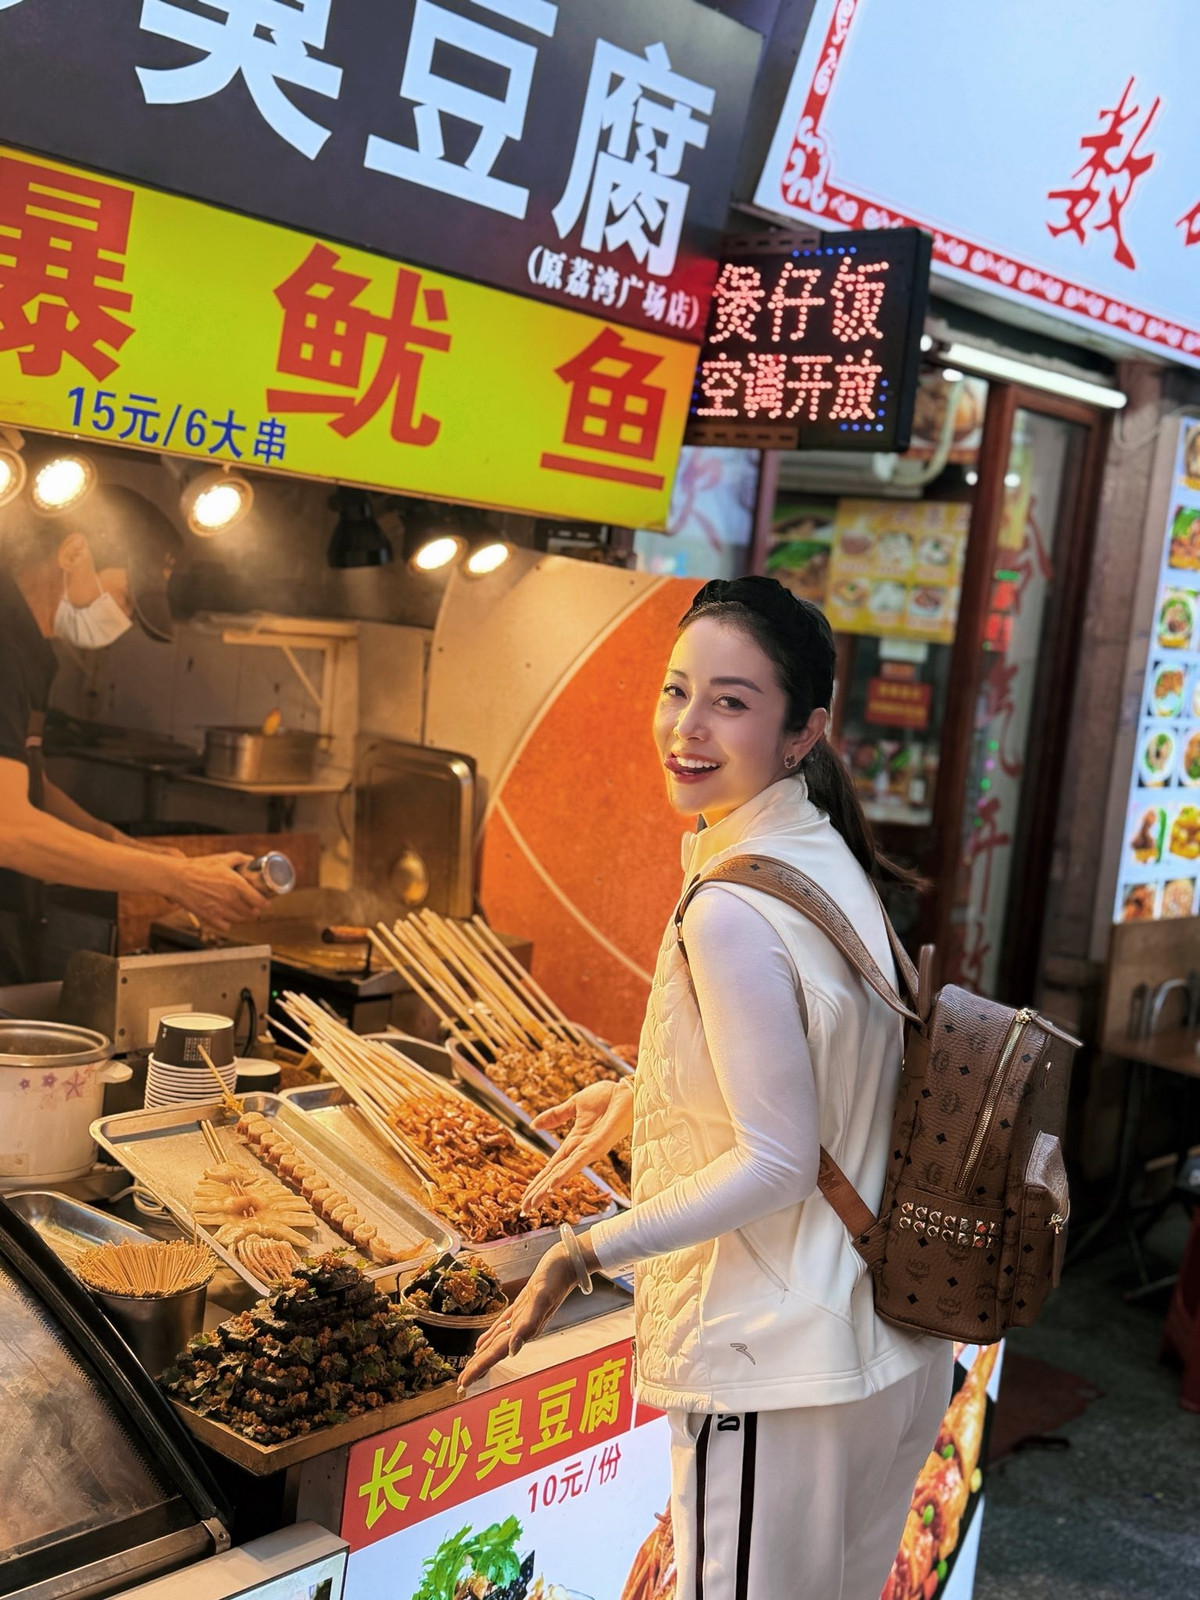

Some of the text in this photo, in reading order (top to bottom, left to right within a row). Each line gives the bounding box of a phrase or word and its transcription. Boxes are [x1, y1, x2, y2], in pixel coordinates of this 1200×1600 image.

[0, 0, 716, 277] 臭豆腐
[1046, 75, 1200, 270] 数
[709, 256, 889, 343] 煲仔饭
[68, 386, 287, 465] 15元/6大串
[696, 348, 883, 421] 空调开放
[358, 1356, 627, 1531] 长沙臭豆腐
[527, 1442, 622, 1514] 10元/份
